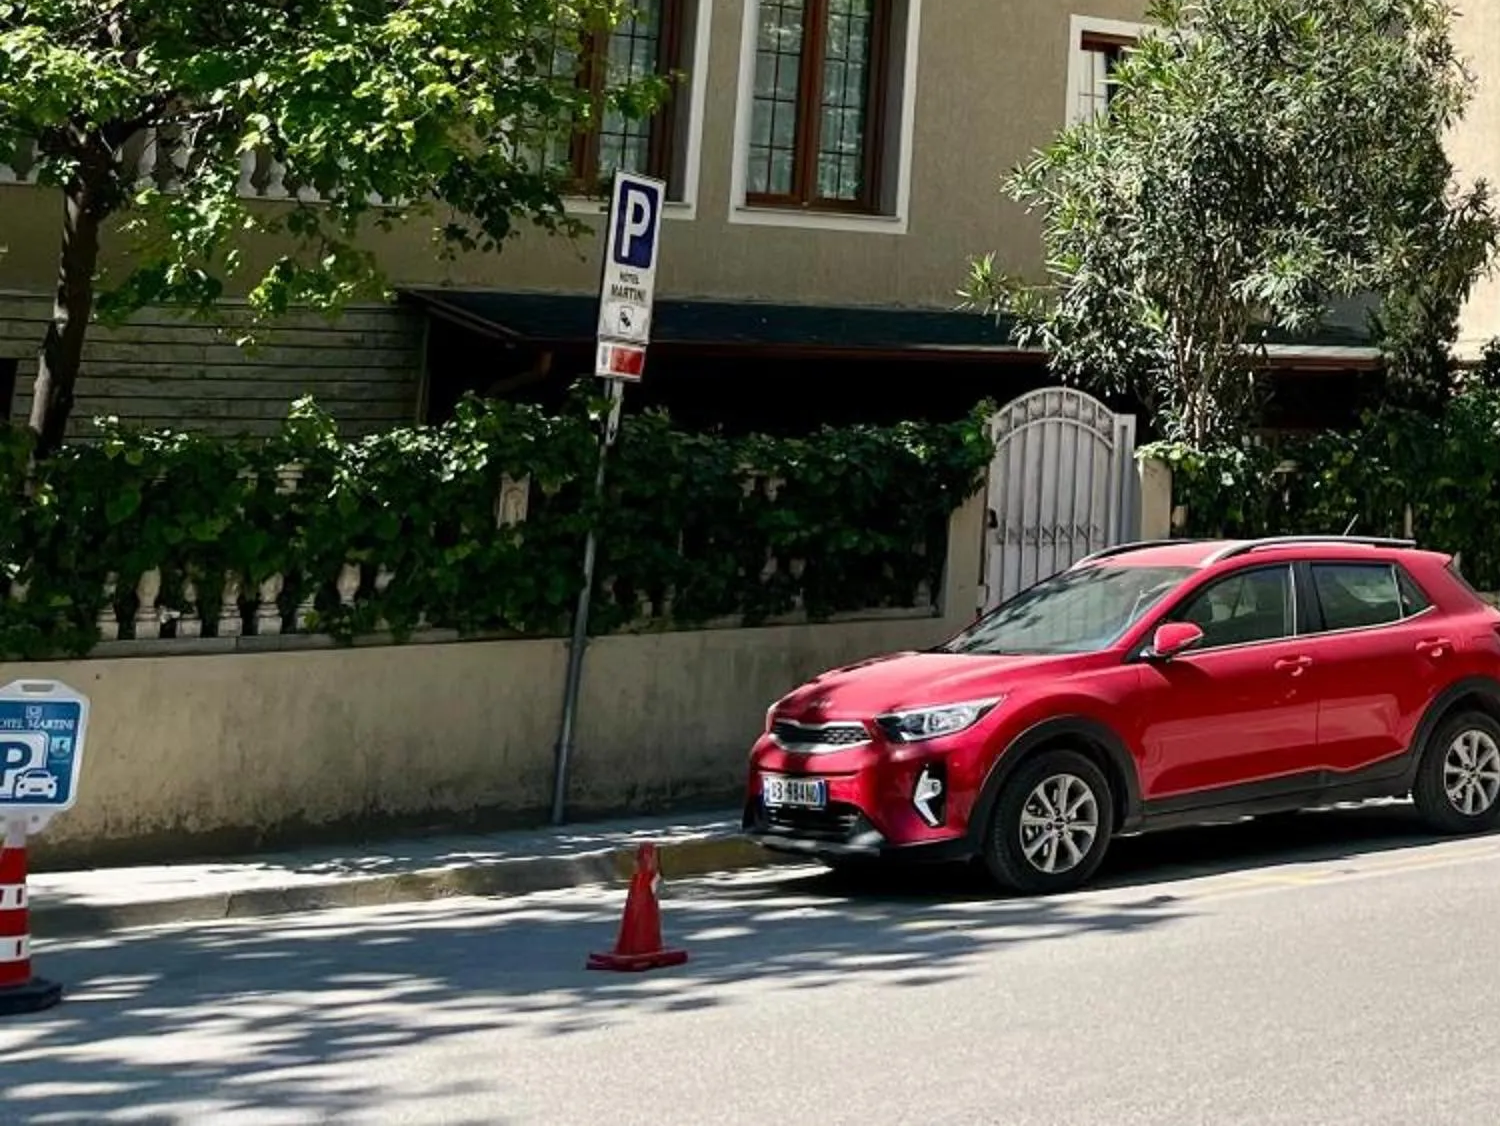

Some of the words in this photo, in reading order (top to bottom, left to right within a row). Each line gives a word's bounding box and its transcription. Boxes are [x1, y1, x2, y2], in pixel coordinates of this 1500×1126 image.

[621, 189, 650, 258] P
[0, 718, 24, 729] OTEL
[0, 742, 32, 787] P
